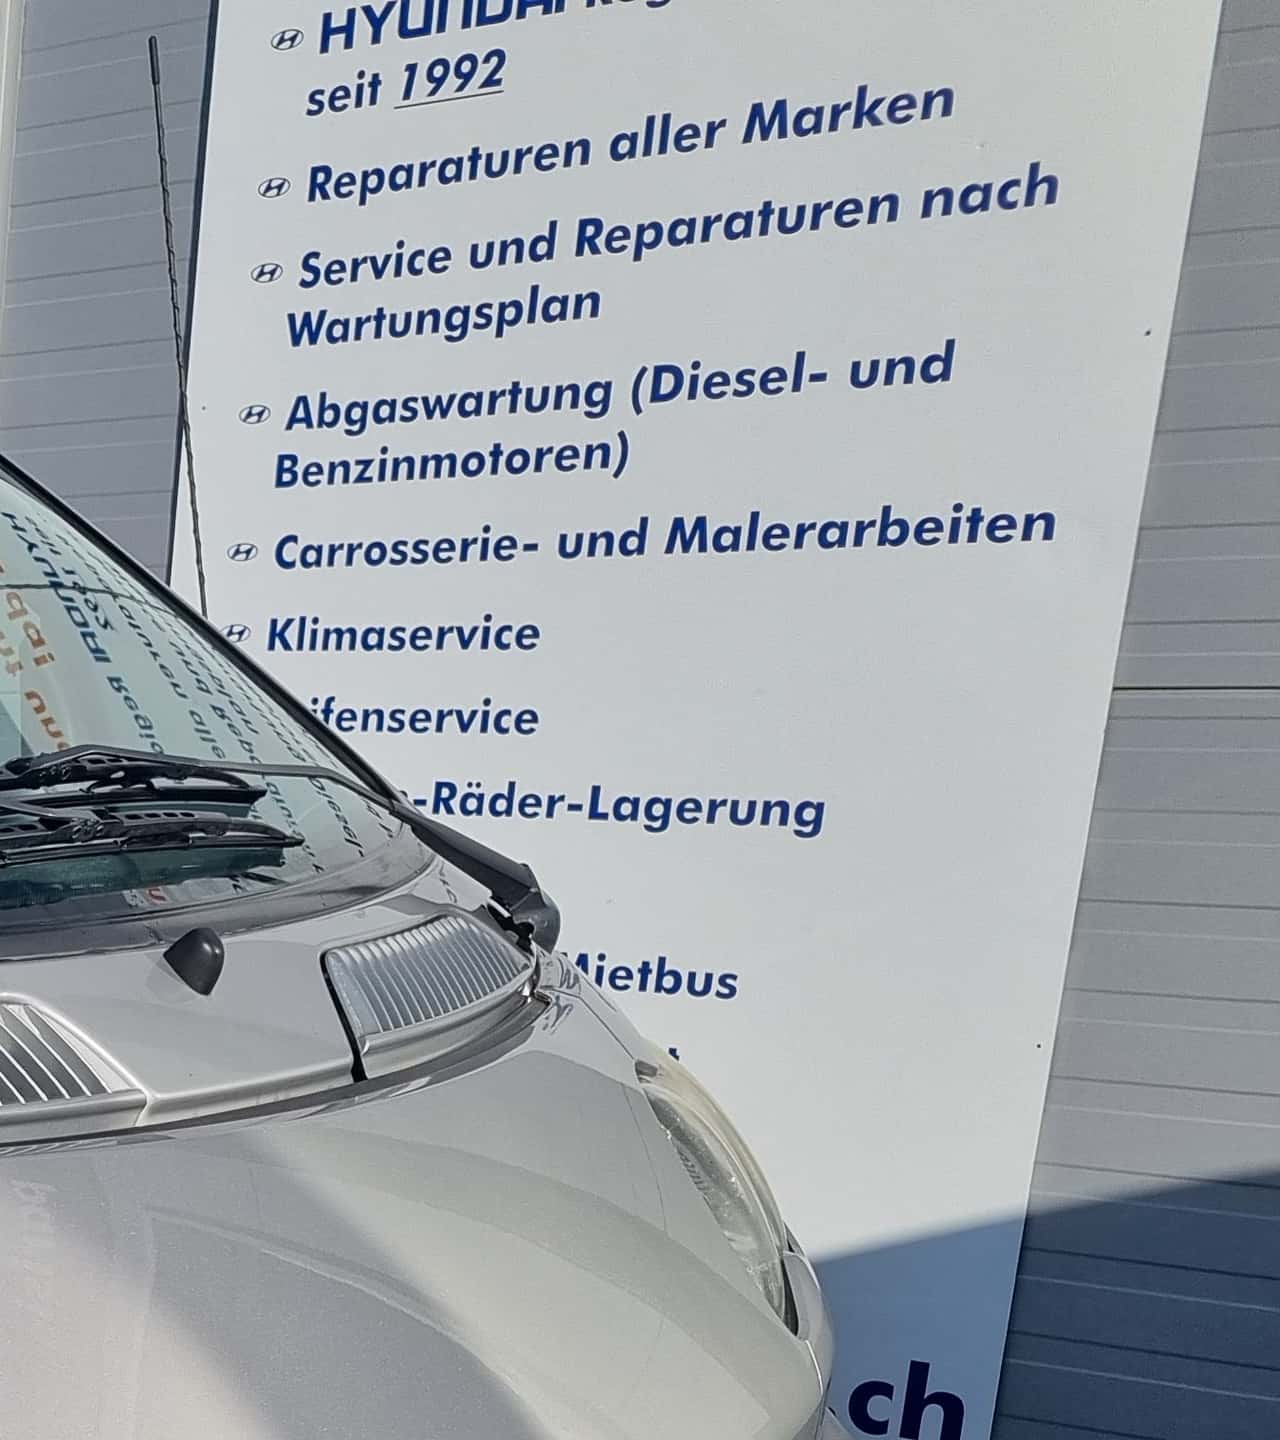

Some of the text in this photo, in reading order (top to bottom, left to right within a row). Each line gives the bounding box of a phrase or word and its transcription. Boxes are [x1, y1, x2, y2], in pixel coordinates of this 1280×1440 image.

[309, 48, 507, 115] seit 1992
[308, 86, 954, 203] Reparaturen aller Marken
[301, 163, 1057, 288] Service und Reparaturen nach
[287, 285, 601, 347] Wartungsplan
[285, 338, 955, 436] Abgaswartung (Diesel- und
[274, 430, 630, 488] Benzinmotoren)
[274, 503, 1056, 570] Carrosserie- und Malerarbeiten
[267, 615, 540, 652] Klimaservice
[311, 696, 539, 735] ifenservice
[415, 781, 825, 838] -Räder-Lagerung
